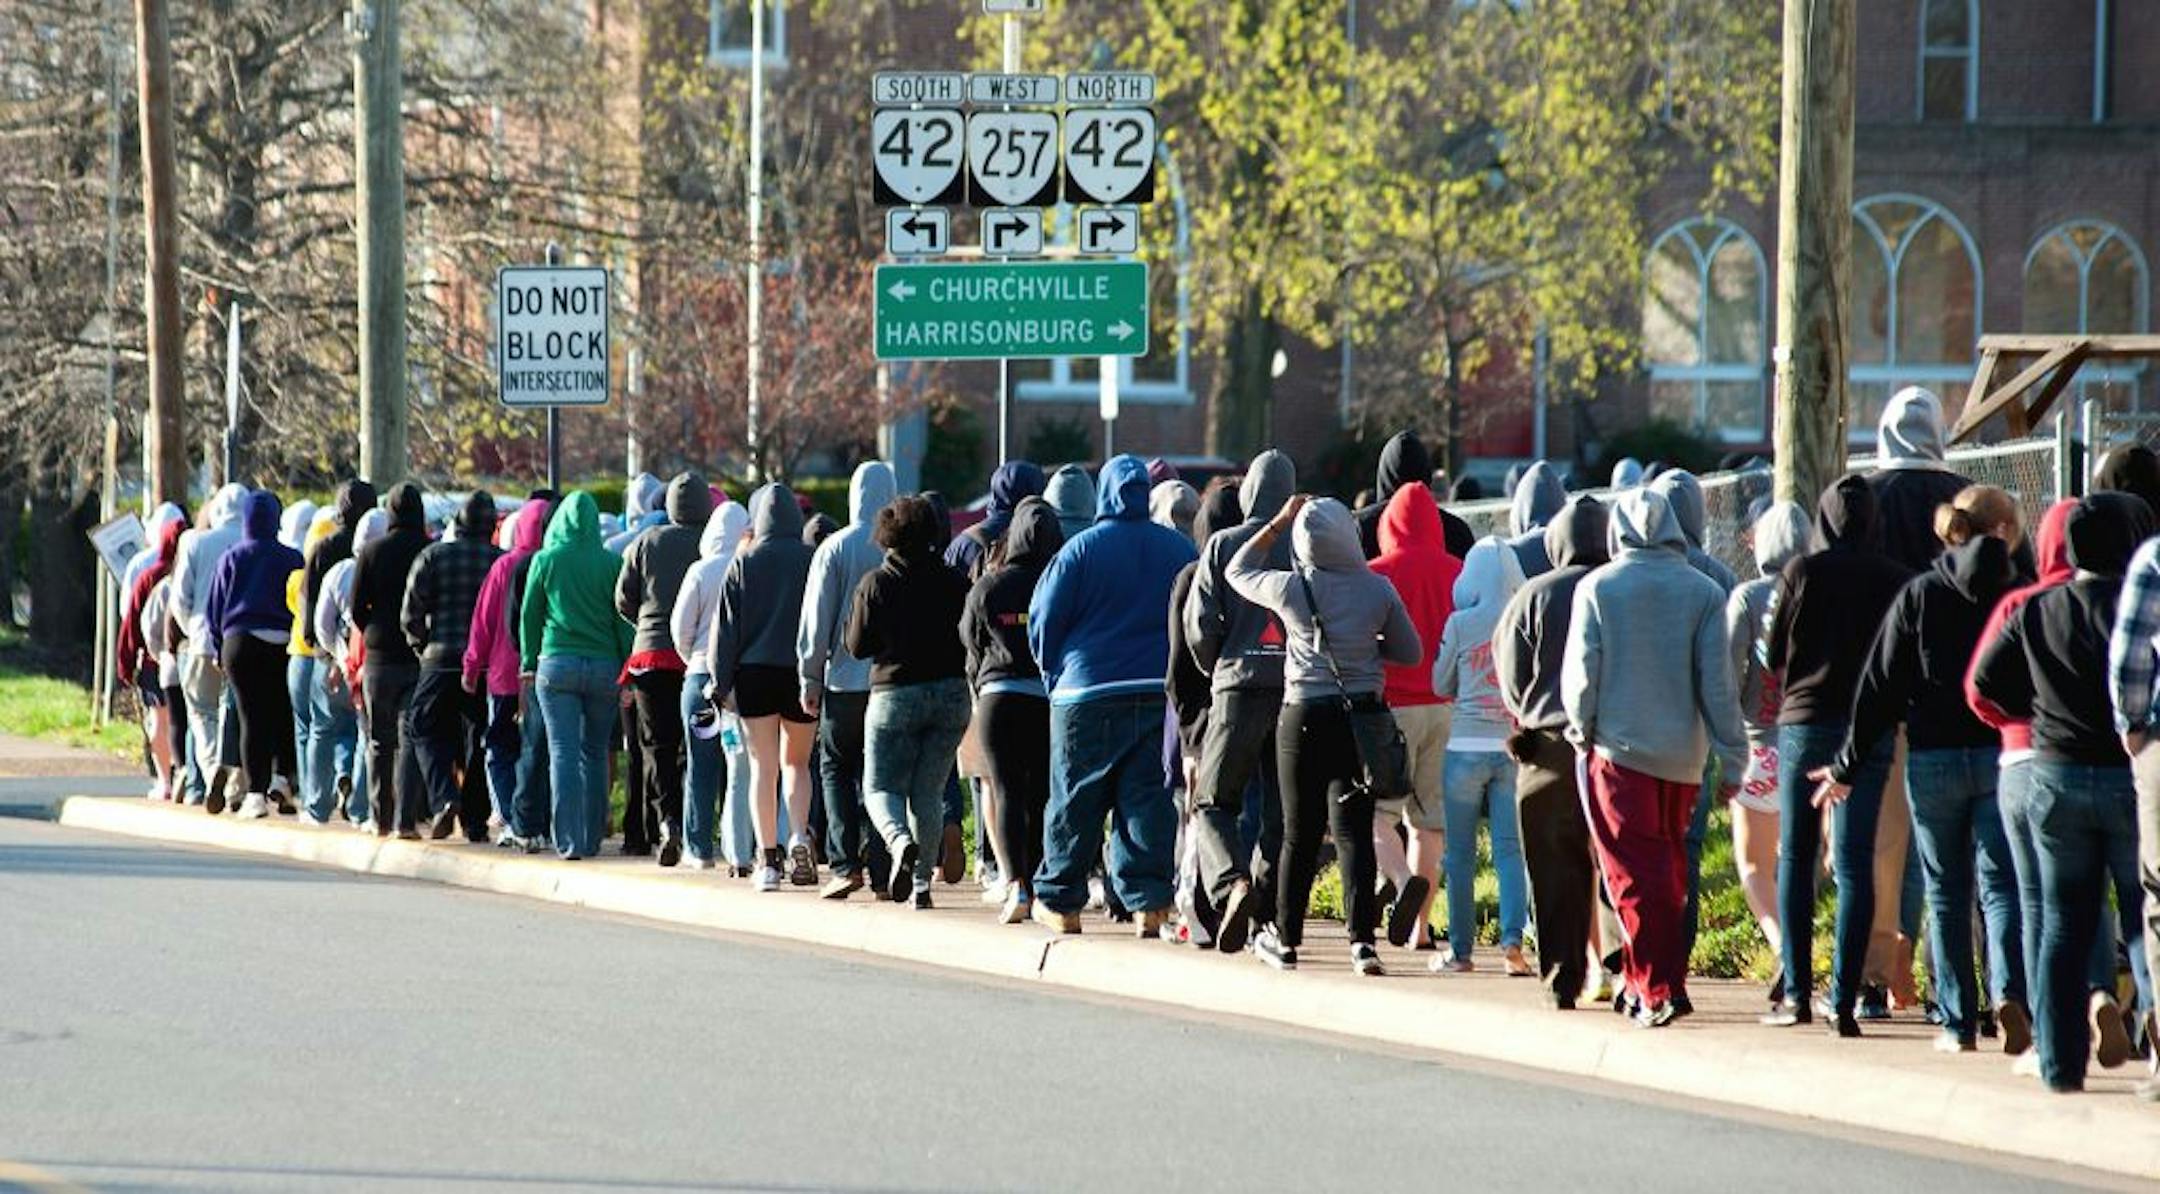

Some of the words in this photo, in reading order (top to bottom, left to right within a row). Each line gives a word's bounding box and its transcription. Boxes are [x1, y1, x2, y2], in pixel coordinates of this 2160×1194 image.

[888, 79, 951, 100] SOUTH
[990, 80, 1040, 99] WEST
[1078, 79, 1141, 99] NORTH
[879, 118, 954, 167] 42
[982, 129, 1049, 179] 257
[1071, 118, 1144, 167] 42
[508, 286, 542, 315] DO
[552, 286, 604, 316] NOT
[929, 276, 1109, 302] CHURCHVILLE
[508, 331, 604, 361] BLOCK
[885, 319, 1094, 346] HARRISONBURG
[506, 370, 604, 392] INTERSECTION
